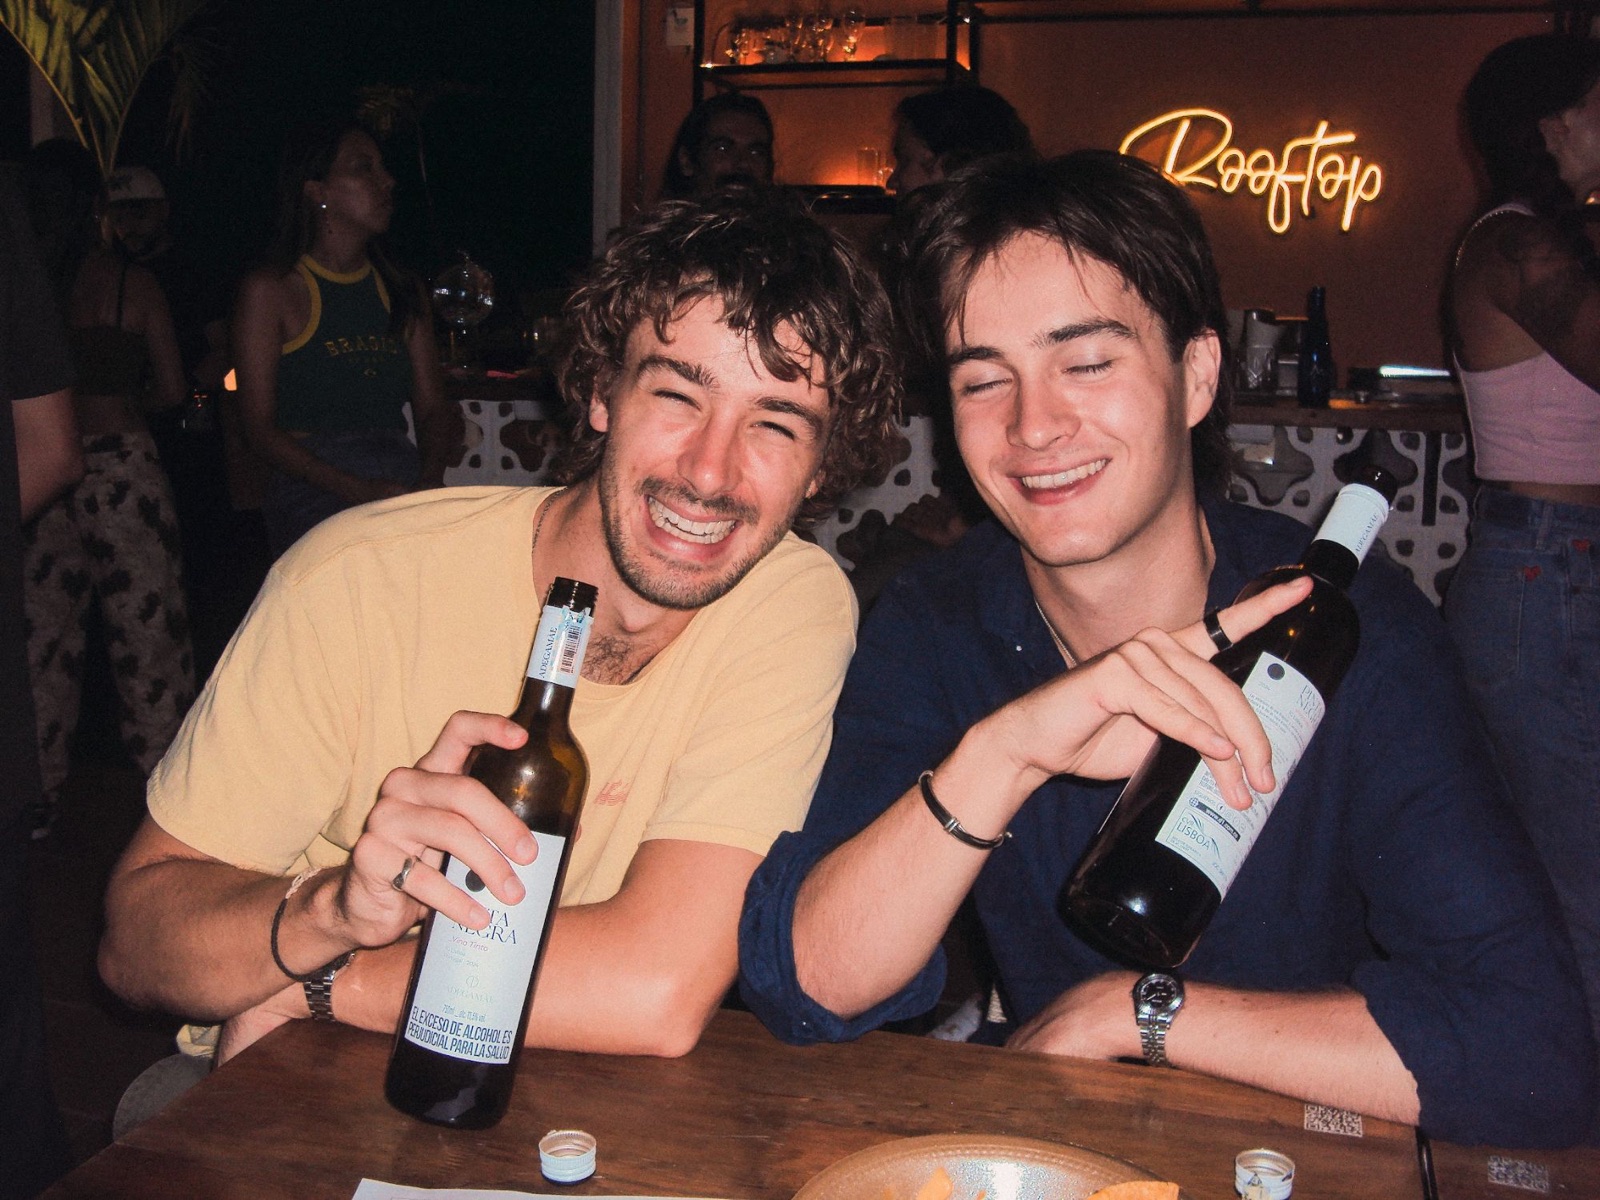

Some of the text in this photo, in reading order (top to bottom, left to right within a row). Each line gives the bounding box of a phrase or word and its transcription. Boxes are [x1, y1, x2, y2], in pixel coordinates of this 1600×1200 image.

[1118, 107, 1382, 234] Rooftop
[1176, 821, 1211, 851] LISBOA
[469, 941, 489, 952] Tinto
[406, 1021, 510, 1060] PERJUDICIAL PARA LA SALUD
[411, 1005, 419, 1022] EL
[419, 1009, 450, 1033] EXCESO
[449, 1020, 464, 1037] DE
[462, 1024, 501, 1044] ALCOHOL
[501, 1029, 513, 1045] ES
